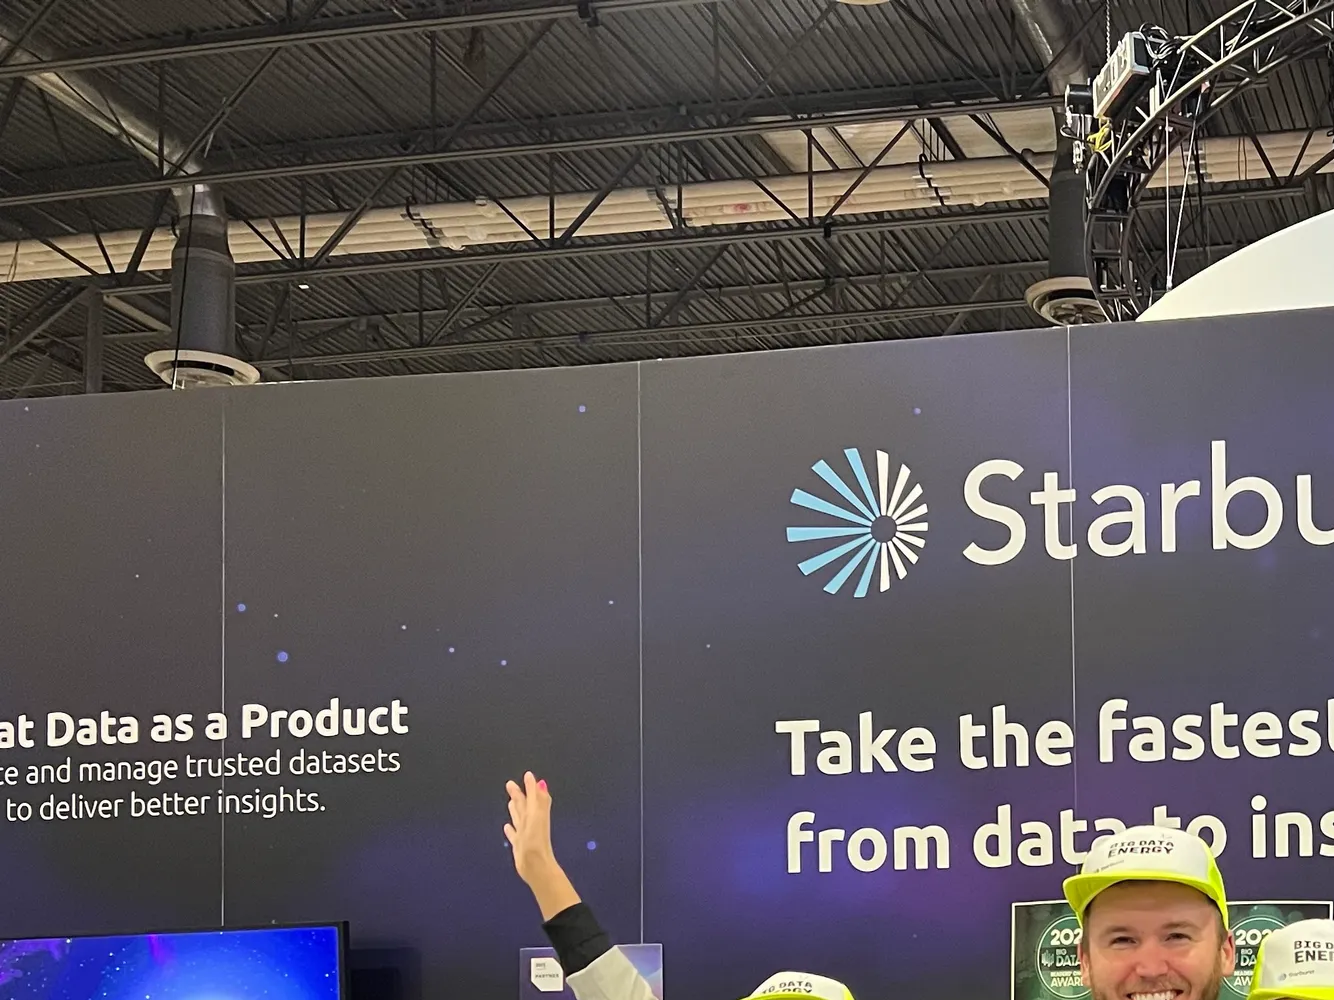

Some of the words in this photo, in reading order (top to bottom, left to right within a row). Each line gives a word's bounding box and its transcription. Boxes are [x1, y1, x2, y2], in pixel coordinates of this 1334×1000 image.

[46, 710, 139, 748] Data
[150, 713, 194, 743] as
[204, 711, 228, 741] a
[241, 698, 409, 739] Product
[775, 710, 937, 777] Take
[958, 704, 1075, 770] the
[26, 757, 71, 784] and
[79, 757, 178, 786] manage
[186, 749, 281, 778] trusted
[289, 748, 401, 775] datasets
[6, 798, 32, 822] to
[39, 794, 125, 820] deliver
[130, 790, 211, 818] better
[217, 786, 326, 819] insights.
[786, 812, 950, 874] from
[1108, 847, 1173, 859] ENERGY
[1139, 840, 1174, 848] DATA
[1294, 940, 1321, 950] BIG
